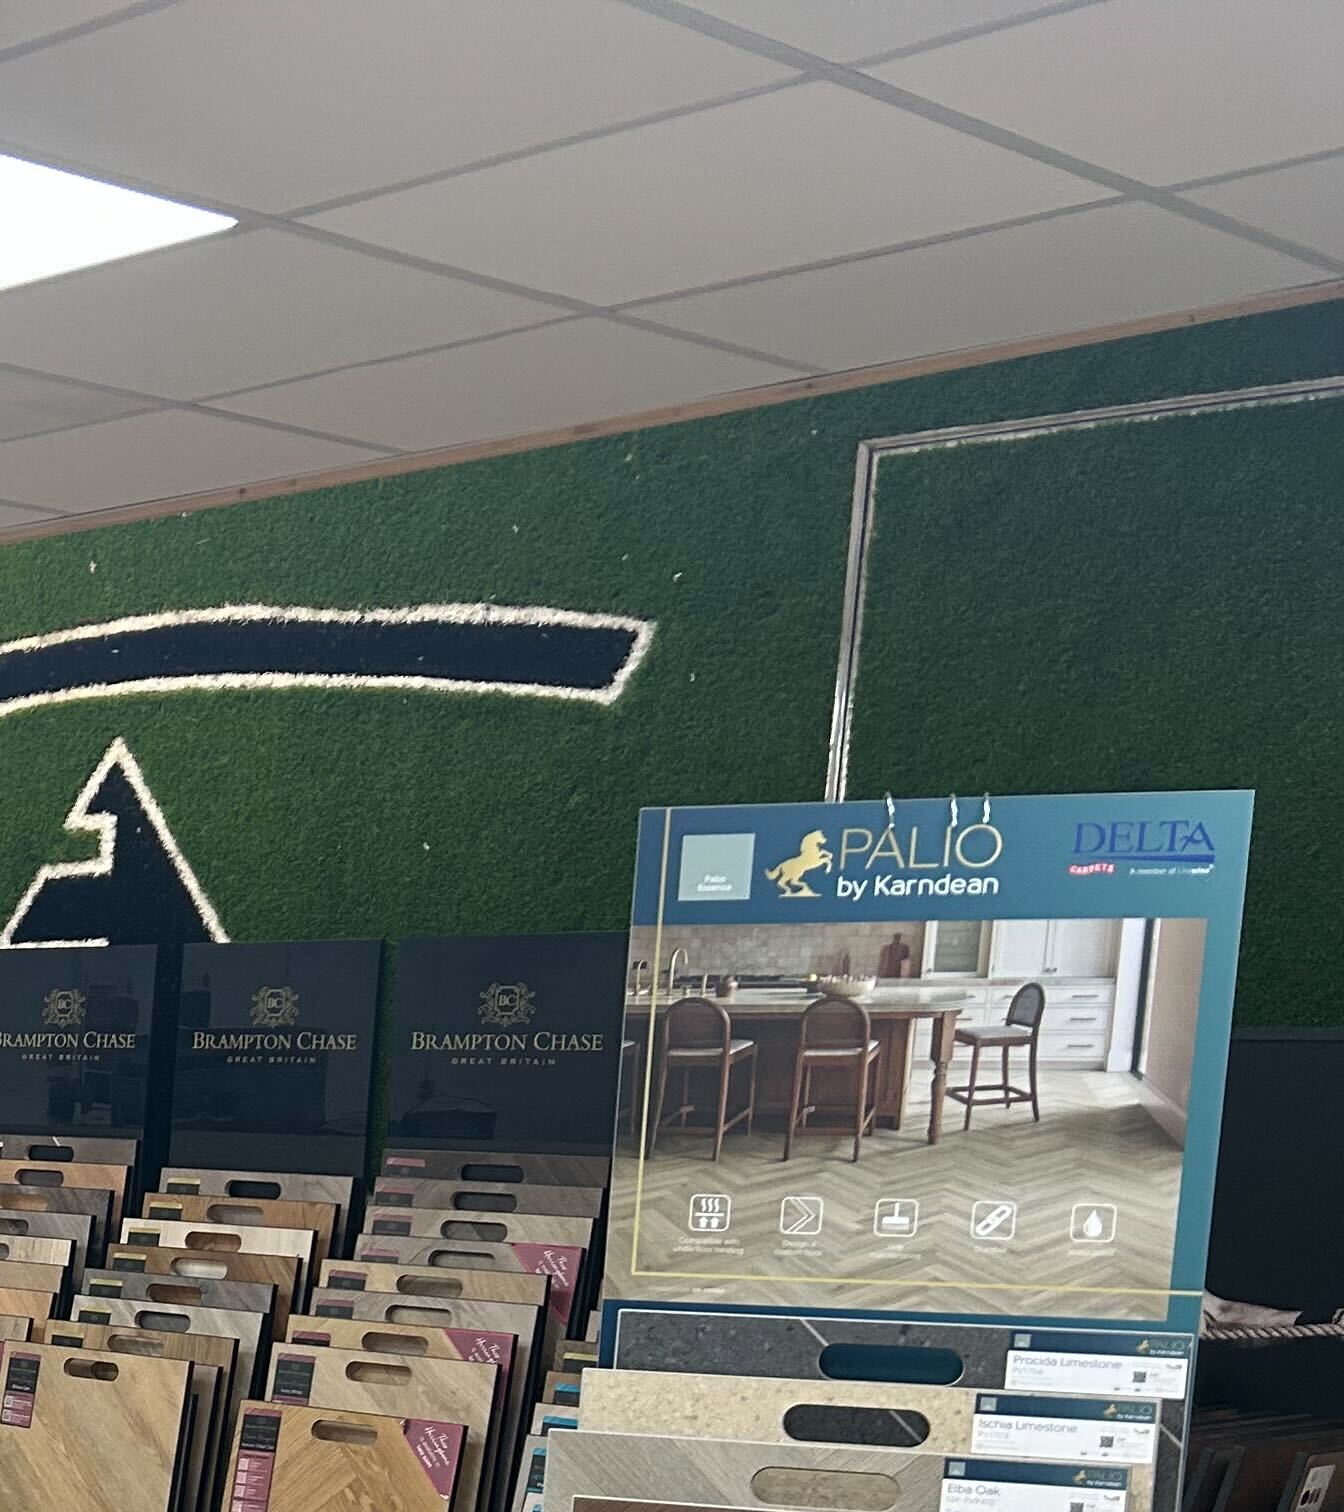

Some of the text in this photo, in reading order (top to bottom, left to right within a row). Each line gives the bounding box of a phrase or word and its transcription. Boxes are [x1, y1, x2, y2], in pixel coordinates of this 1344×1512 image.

[1072, 820, 1216, 855] DELTA
[839, 823, 1004, 871] PALIO
[837, 873, 1000, 900] by Karndean
[82, 1031, 136, 1049] CHASE
[192, 1031, 358, 1050] BRAMPTON CHASE
[410, 1031, 604, 1051] BRAMPTON CHASE
[22, 1053, 54, 1061] GREAT
[226, 1055, 317, 1064] GREAT BRITAIN
[451, 1057, 556, 1066] GREAT BRITAIN
[1013, 1355, 1122, 1369] Procida Limestone
[979, 1420, 1078, 1433] Ischia Limestone
[948, 1484, 1000, 1496] Elba Oak
